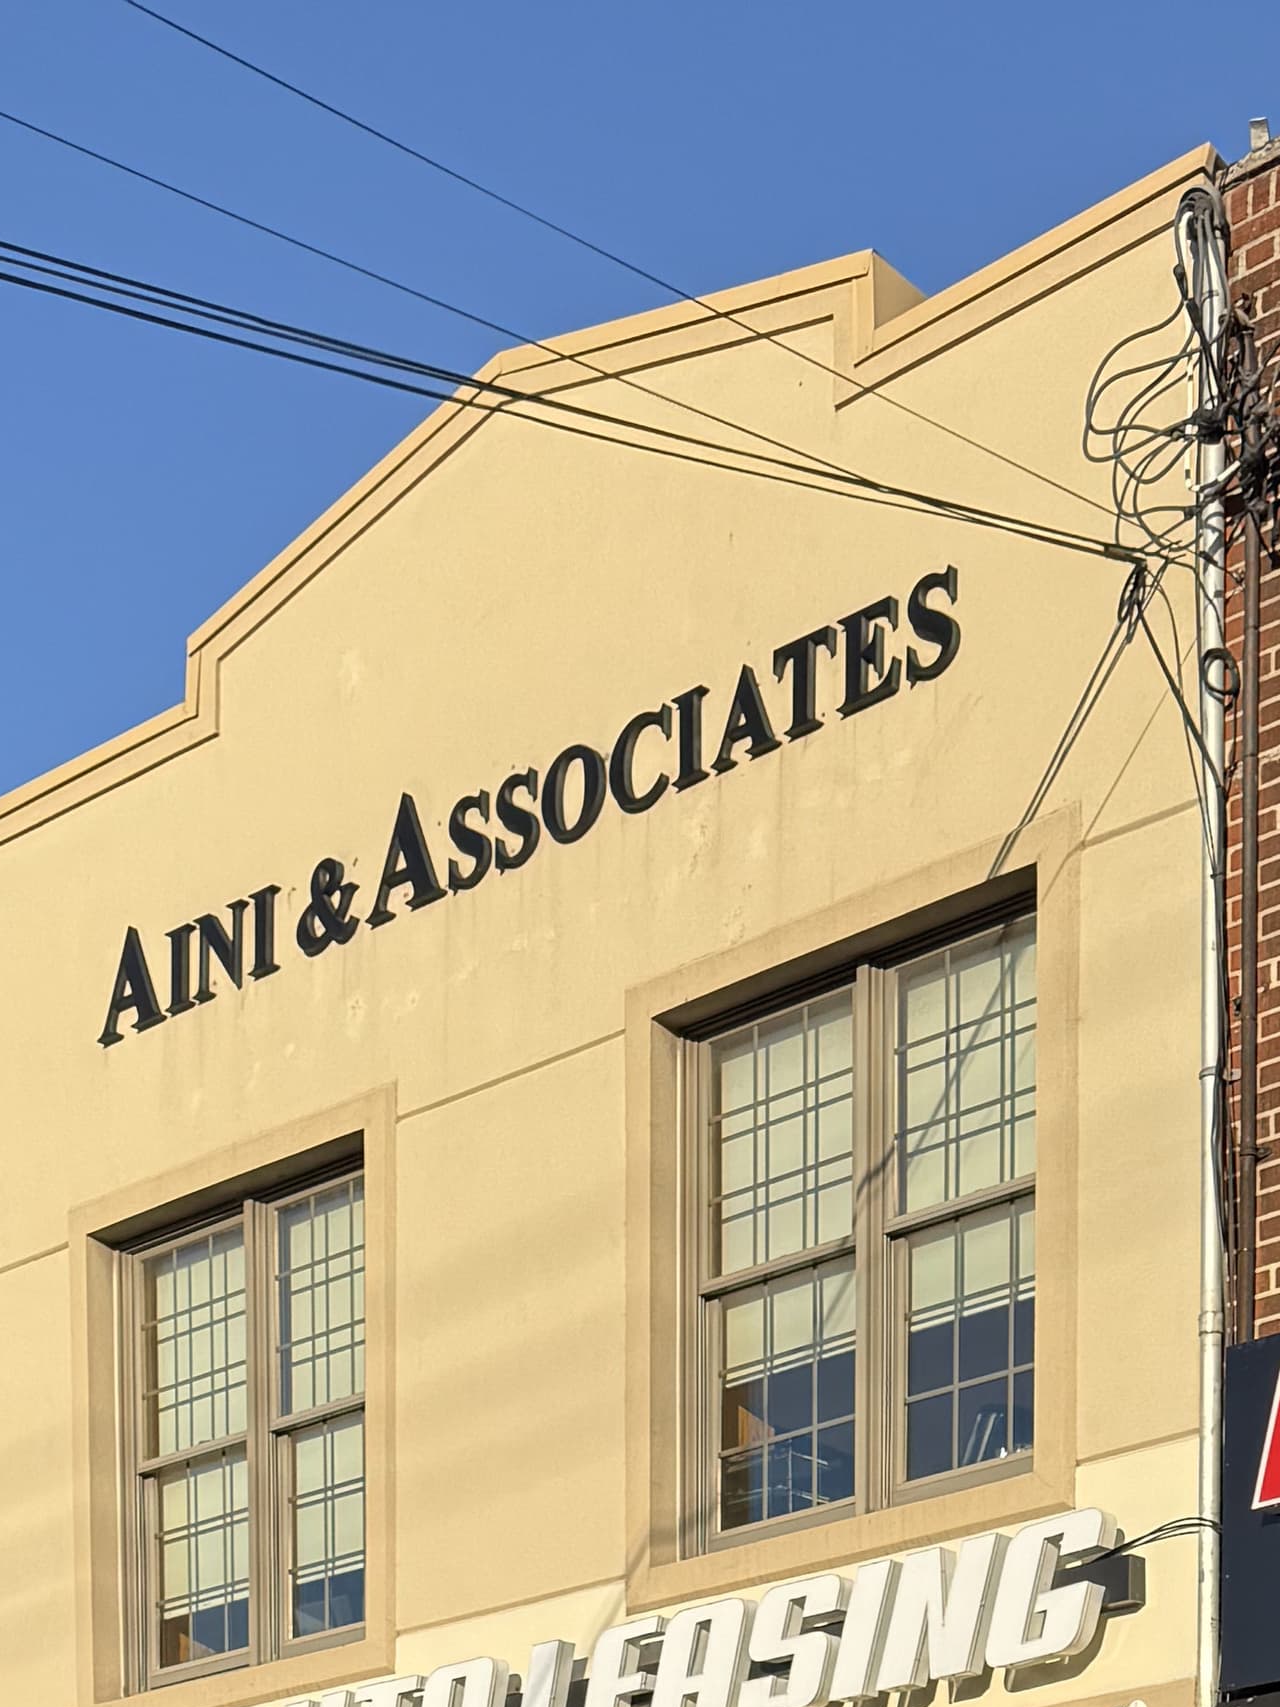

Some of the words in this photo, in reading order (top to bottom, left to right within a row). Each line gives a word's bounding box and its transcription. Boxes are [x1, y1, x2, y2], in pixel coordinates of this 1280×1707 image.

[98, 884, 280, 1048] AINI
[295, 856, 361, 957] &
[365, 564, 959, 930] ASSOCIATES
